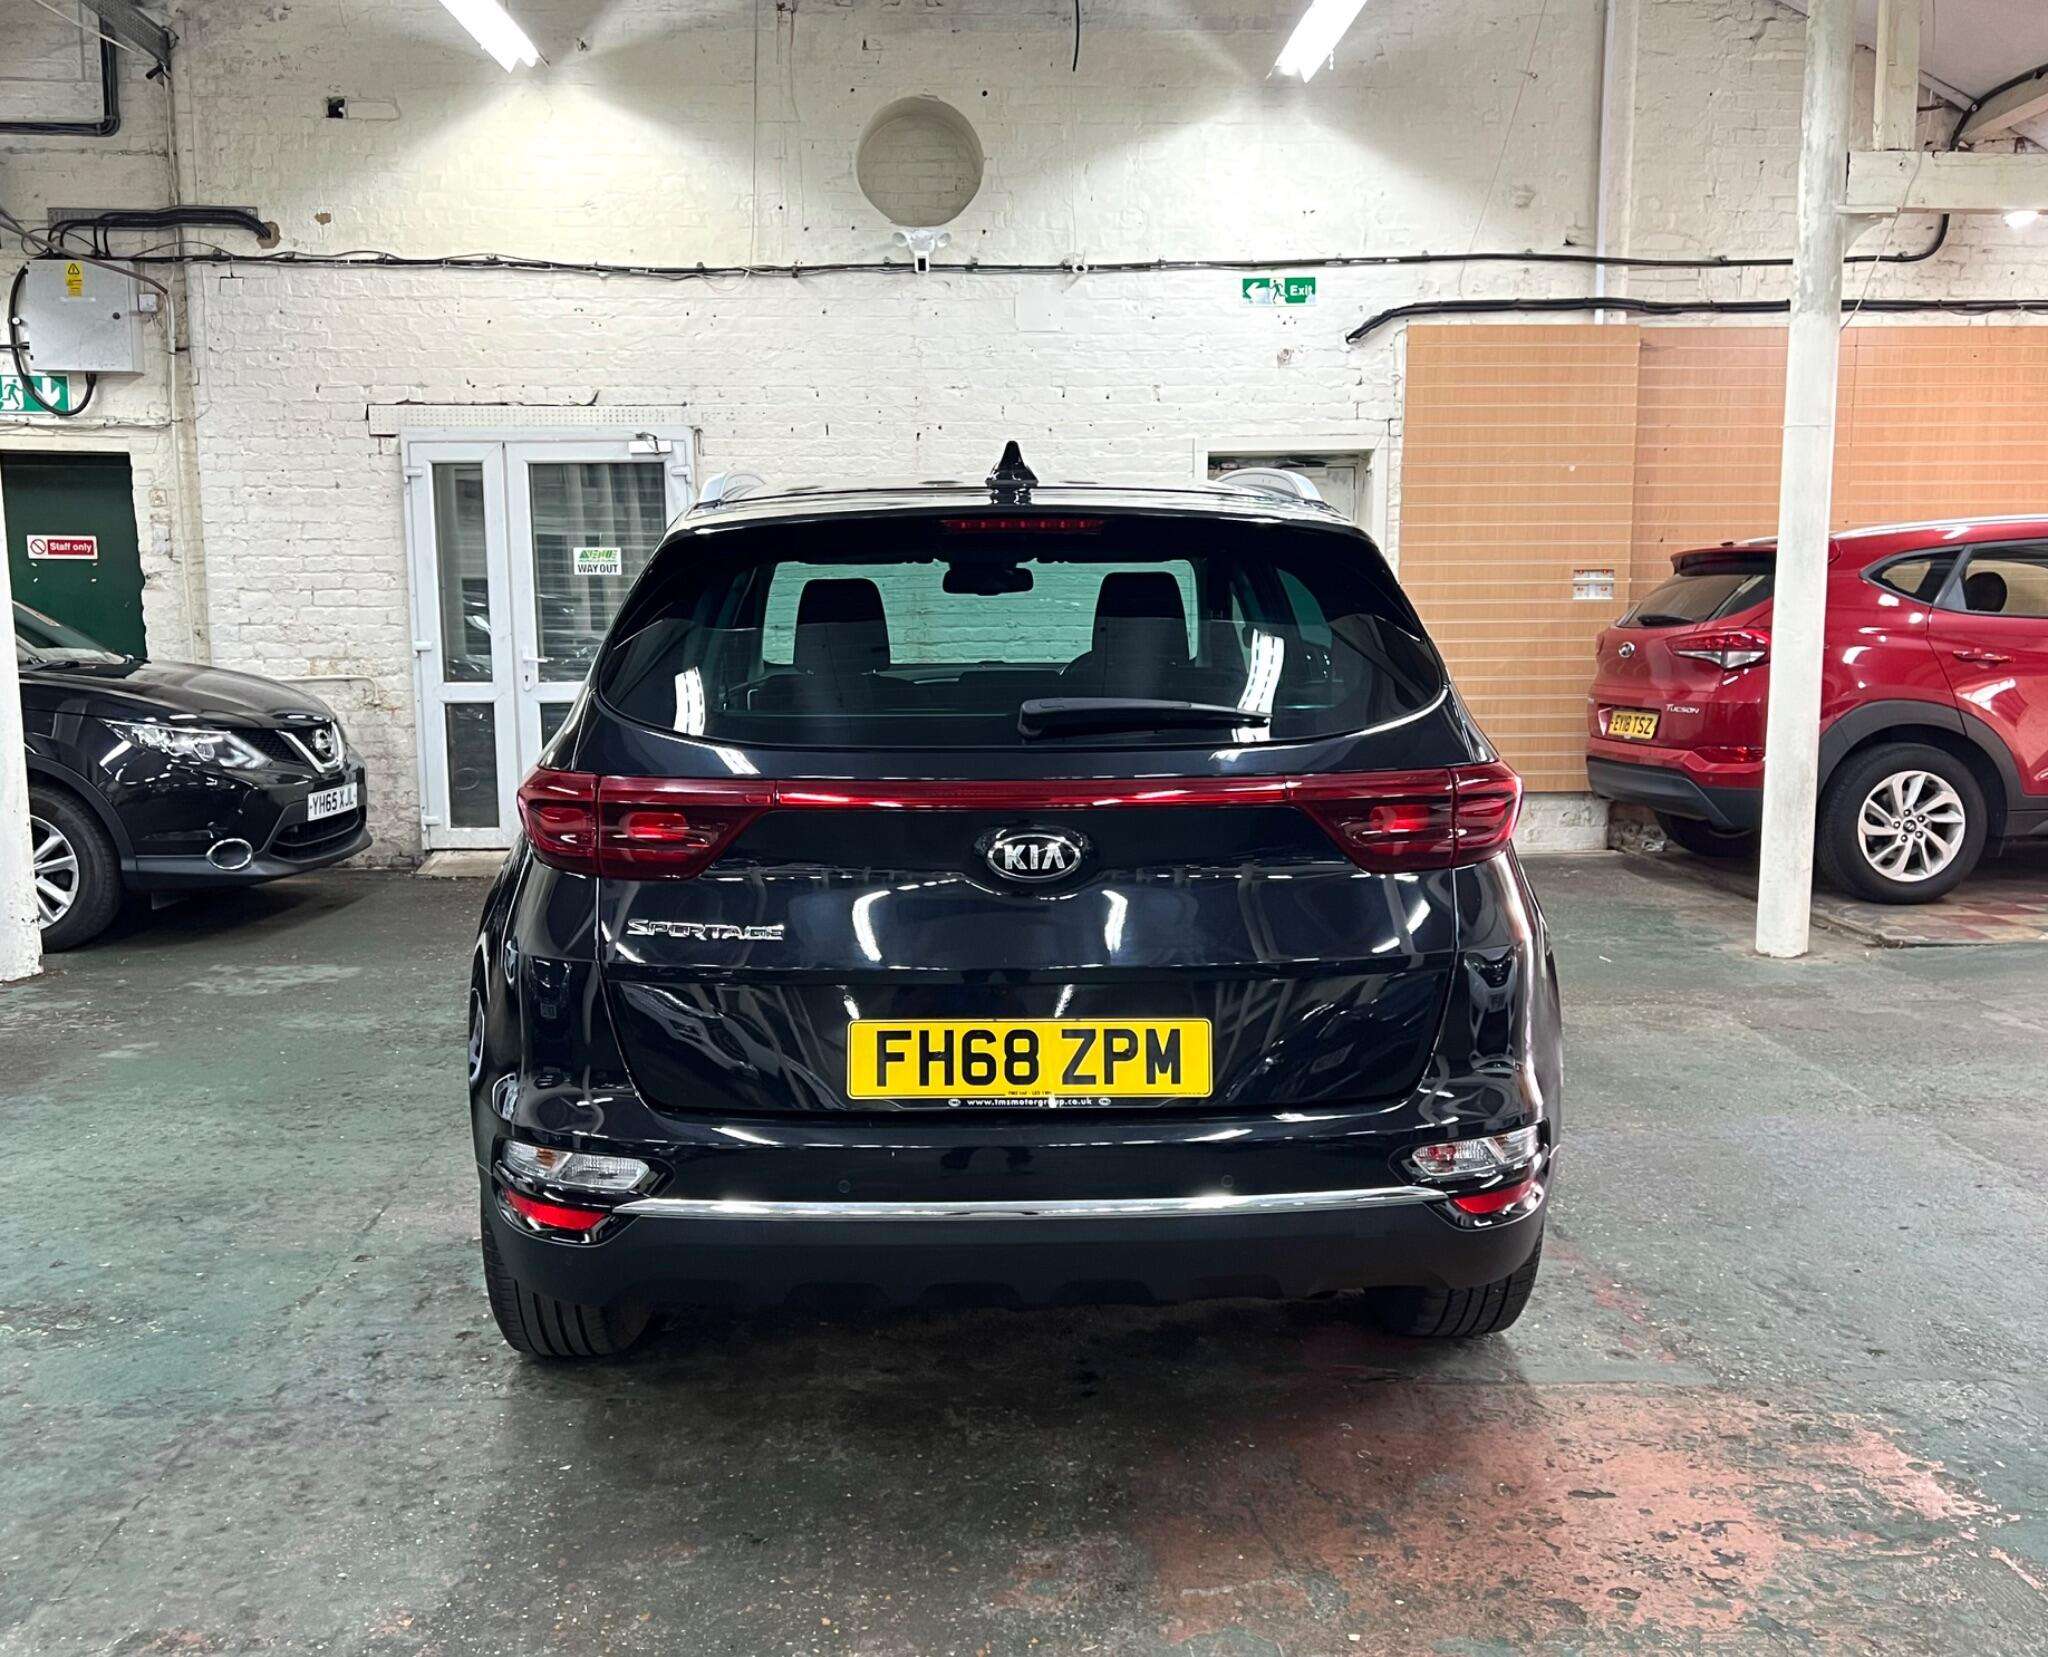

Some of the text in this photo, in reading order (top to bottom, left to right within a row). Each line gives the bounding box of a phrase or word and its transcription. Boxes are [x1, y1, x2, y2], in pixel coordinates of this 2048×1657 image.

[1289, 285, 1313, 297] Exit
[49, 542, 92, 553] Staff only
[577, 564, 618, 573] WAY OUT
[1631, 716, 1654, 735] TSZ
[312, 791, 338, 815] YH65
[1003, 843, 1065, 870] KIA
[626, 918, 784, 941] SPORTAGE
[876, 1028, 1182, 1087] FH68 ZPM
